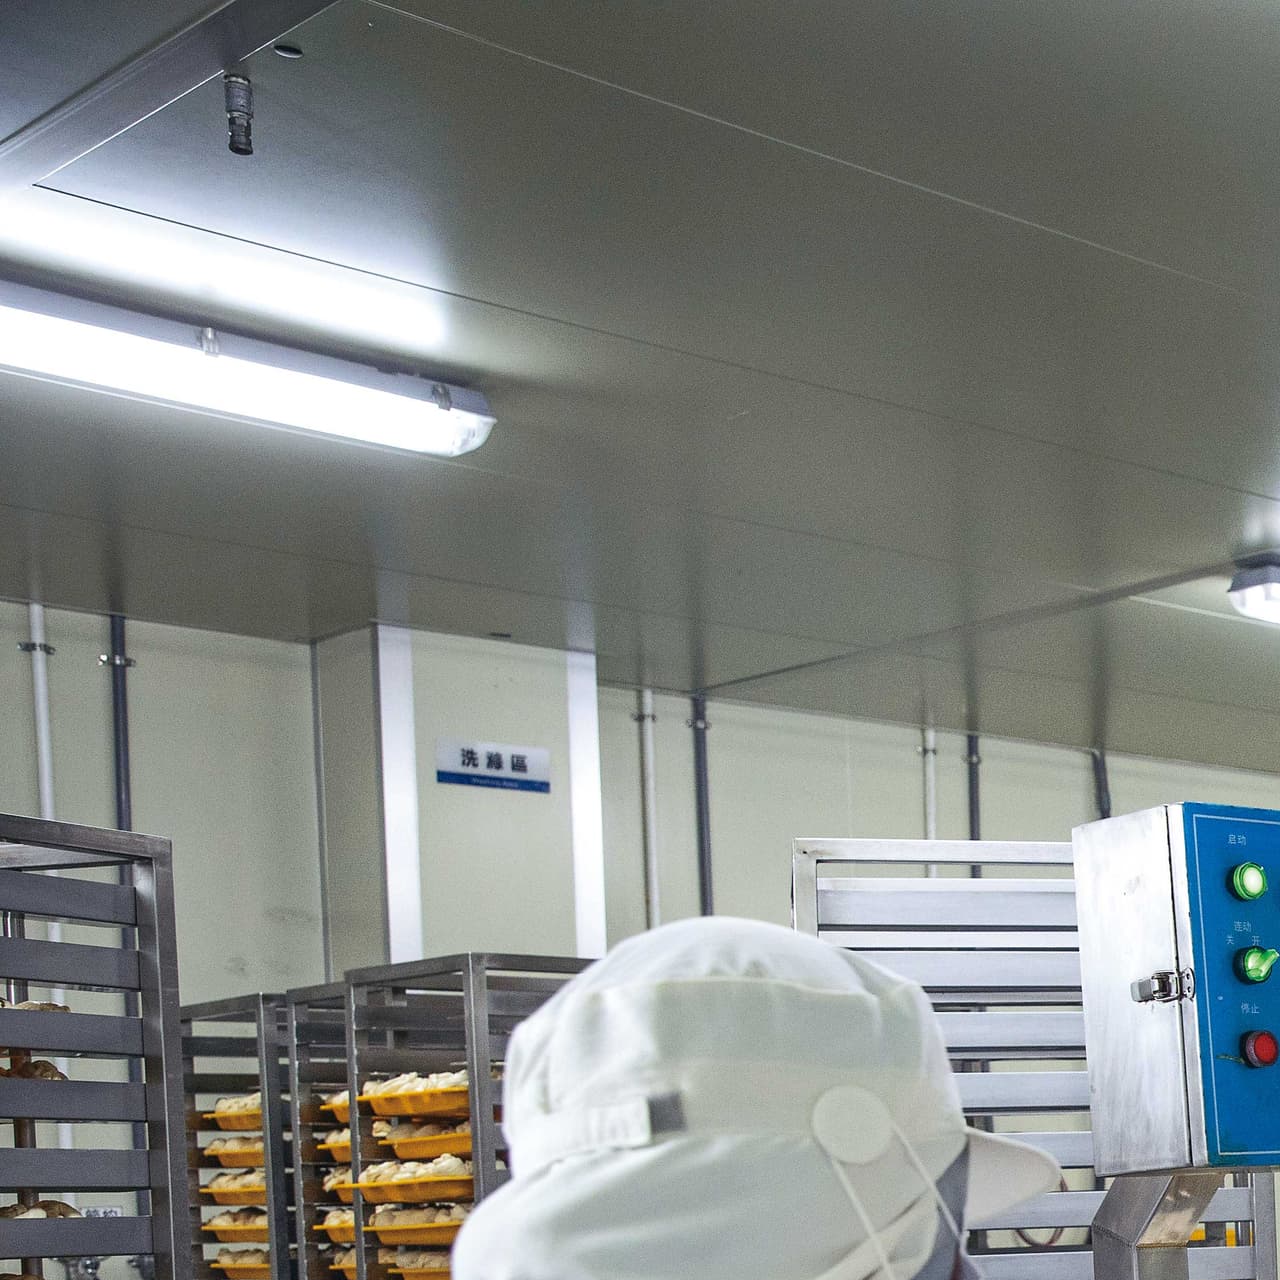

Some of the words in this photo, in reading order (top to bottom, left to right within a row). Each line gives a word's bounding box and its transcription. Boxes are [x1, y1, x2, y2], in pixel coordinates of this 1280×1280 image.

[1228, 834, 1247, 846] 启动
[1251, 935, 1260, 946] 开
[1240, 1002, 1260, 1014] 停止
